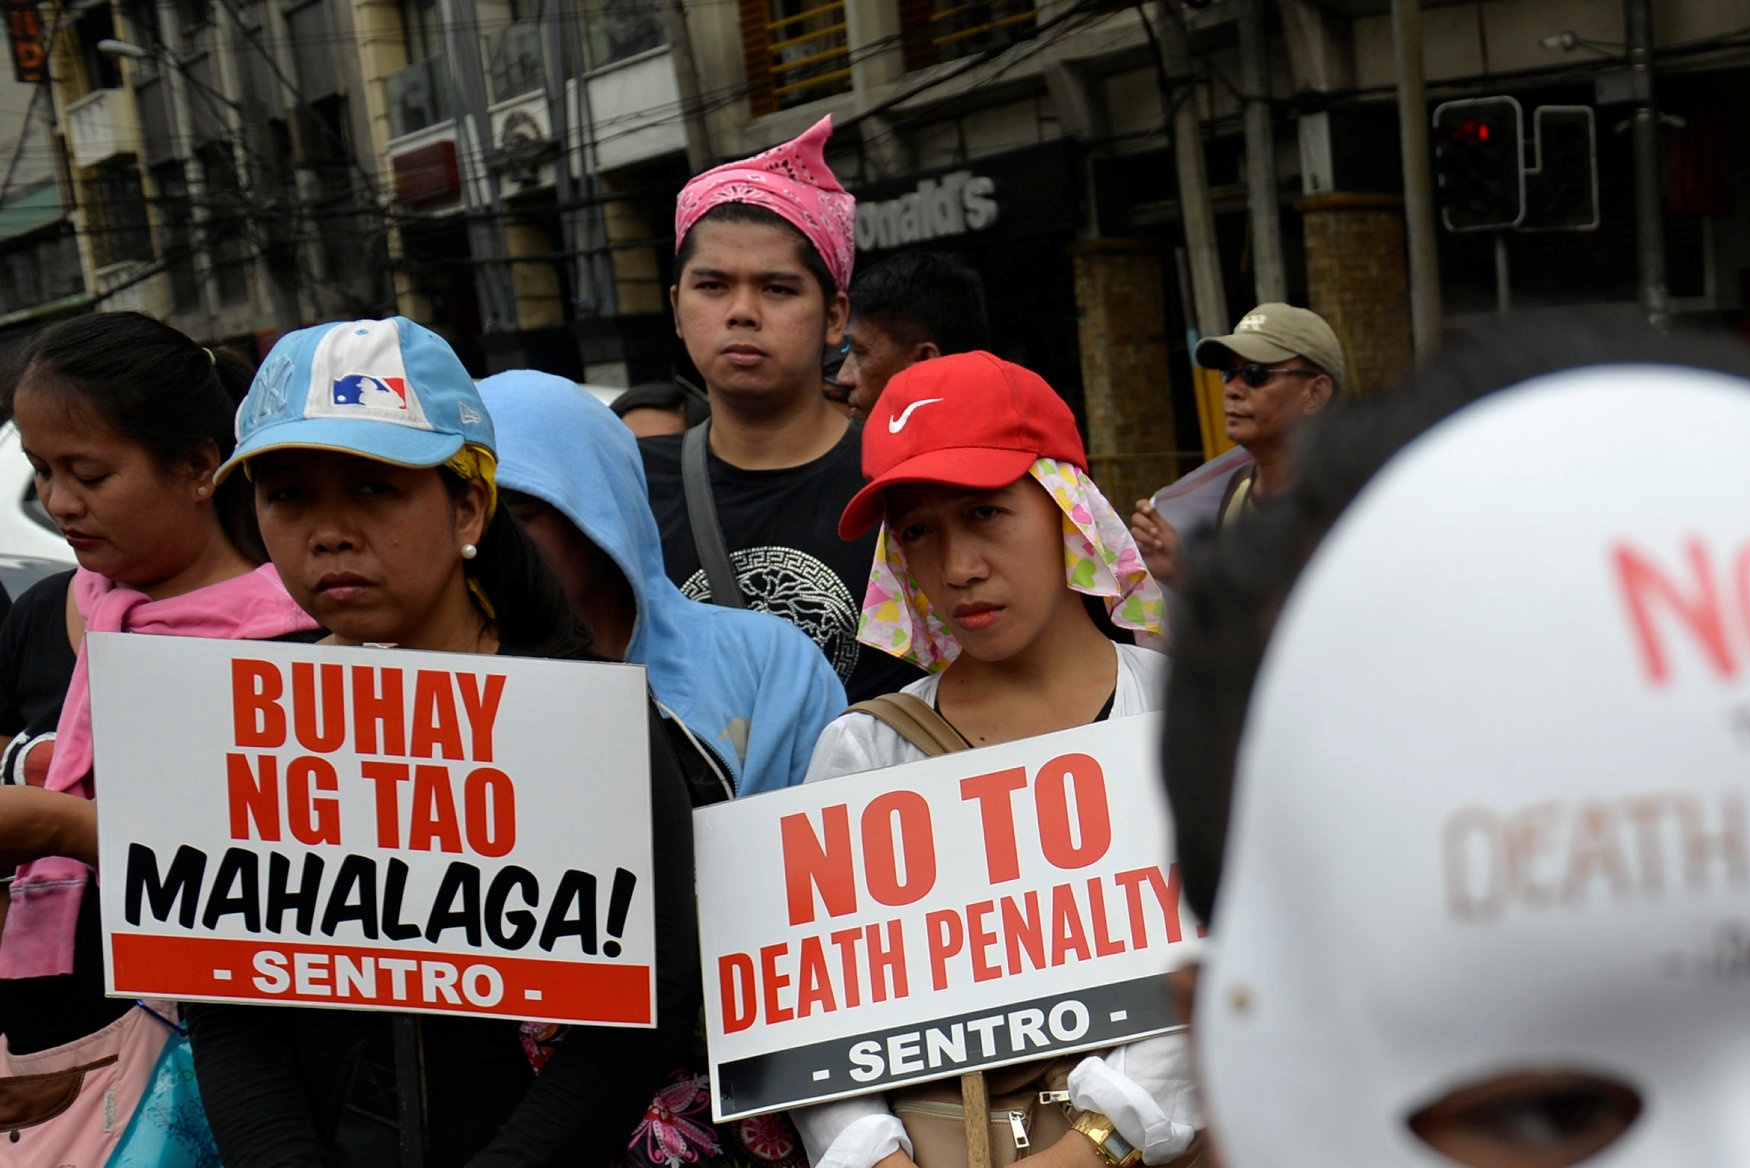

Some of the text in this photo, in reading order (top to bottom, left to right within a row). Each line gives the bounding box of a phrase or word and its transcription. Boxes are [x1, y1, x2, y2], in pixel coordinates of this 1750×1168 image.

[855, 170, 998, 251] onald's
[231, 658, 507, 763] BUHAY
[226, 752, 517, 858] NG TAO
[781, 753, 1112, 926] NO TO
[124, 842, 637, 958] MAHALAGA!
[718, 862, 1209, 1035] DEATH PENALTY
[252, 950, 505, 1008] SENTRO
[848, 999, 1090, 1083] SENTRO
